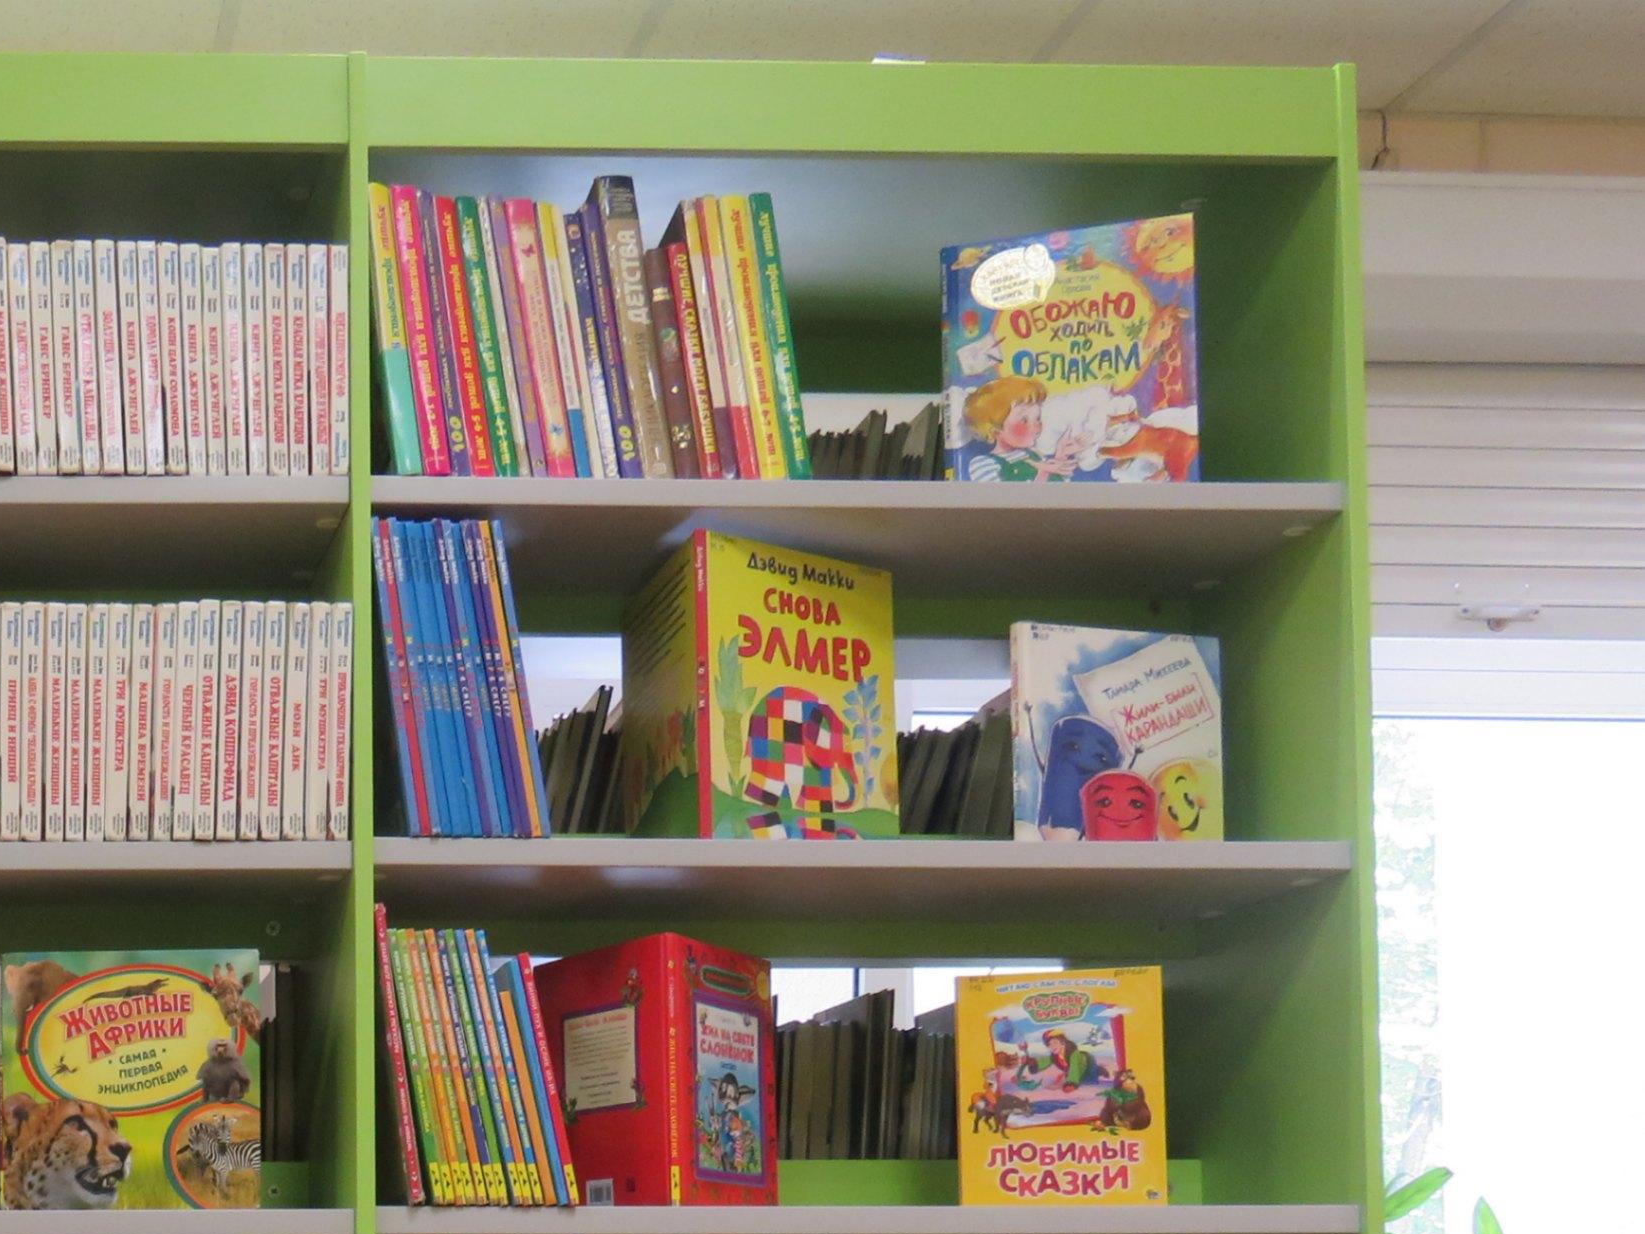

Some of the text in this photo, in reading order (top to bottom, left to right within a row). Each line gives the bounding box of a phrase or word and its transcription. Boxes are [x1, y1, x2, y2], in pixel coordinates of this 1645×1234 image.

[1012, 341, 1141, 385] ОБЛАКАМ
[746, 552, 855, 590] Дэвид Макки
[764, 588, 841, 626] СНОВА
[738, 614, 871, 682] ЭЛМЕР
[71, 679, 80, 806] МАЛЕНЬКИЕ ЖЕНЩИНЫ
[222, 675, 237, 802] ДЭВИД КОППЕРФИЛД
[59, 994, 191, 1039] ЖИВОТНЫЕ
[88, 1018, 184, 1059] АФРИКИ
[119, 1049, 156, 1064] САМАЯ
[98, 1065, 188, 1094] ЭНЦИКЛОПЕДИЯ
[119, 1062, 162, 1078] ПЕРВАЯ
[987, 1140, 1140, 1168] ЛЮБИМЫЕ
[998, 1164, 1129, 1197] СКАЗКИ
